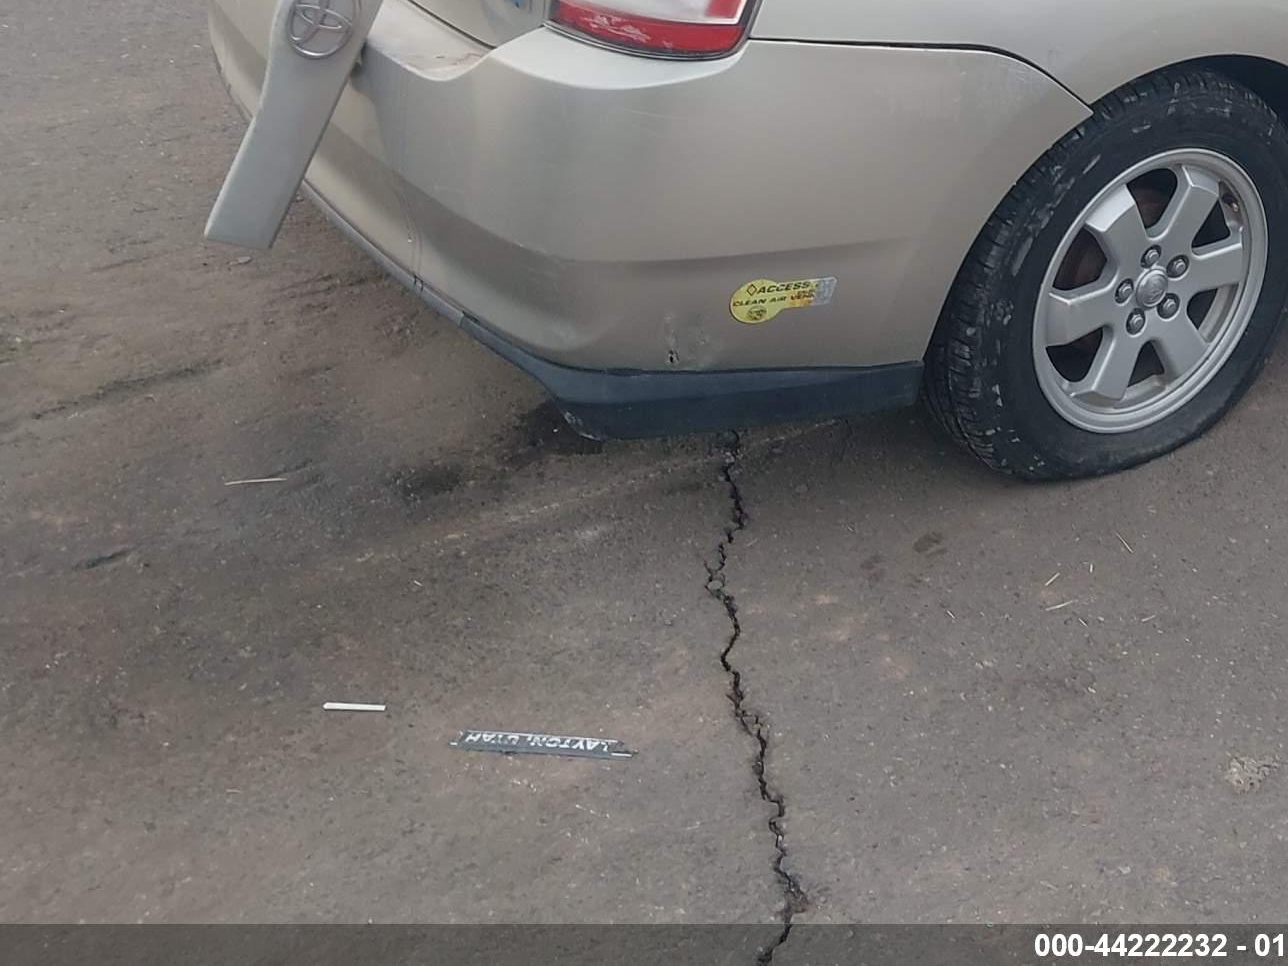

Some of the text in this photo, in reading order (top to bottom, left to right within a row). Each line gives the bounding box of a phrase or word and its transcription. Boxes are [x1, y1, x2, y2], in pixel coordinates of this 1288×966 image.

[757, 281, 811, 295] ACCESS
[733, 298, 768, 307] CLEAN
[465, 732, 519, 745] UTAH
